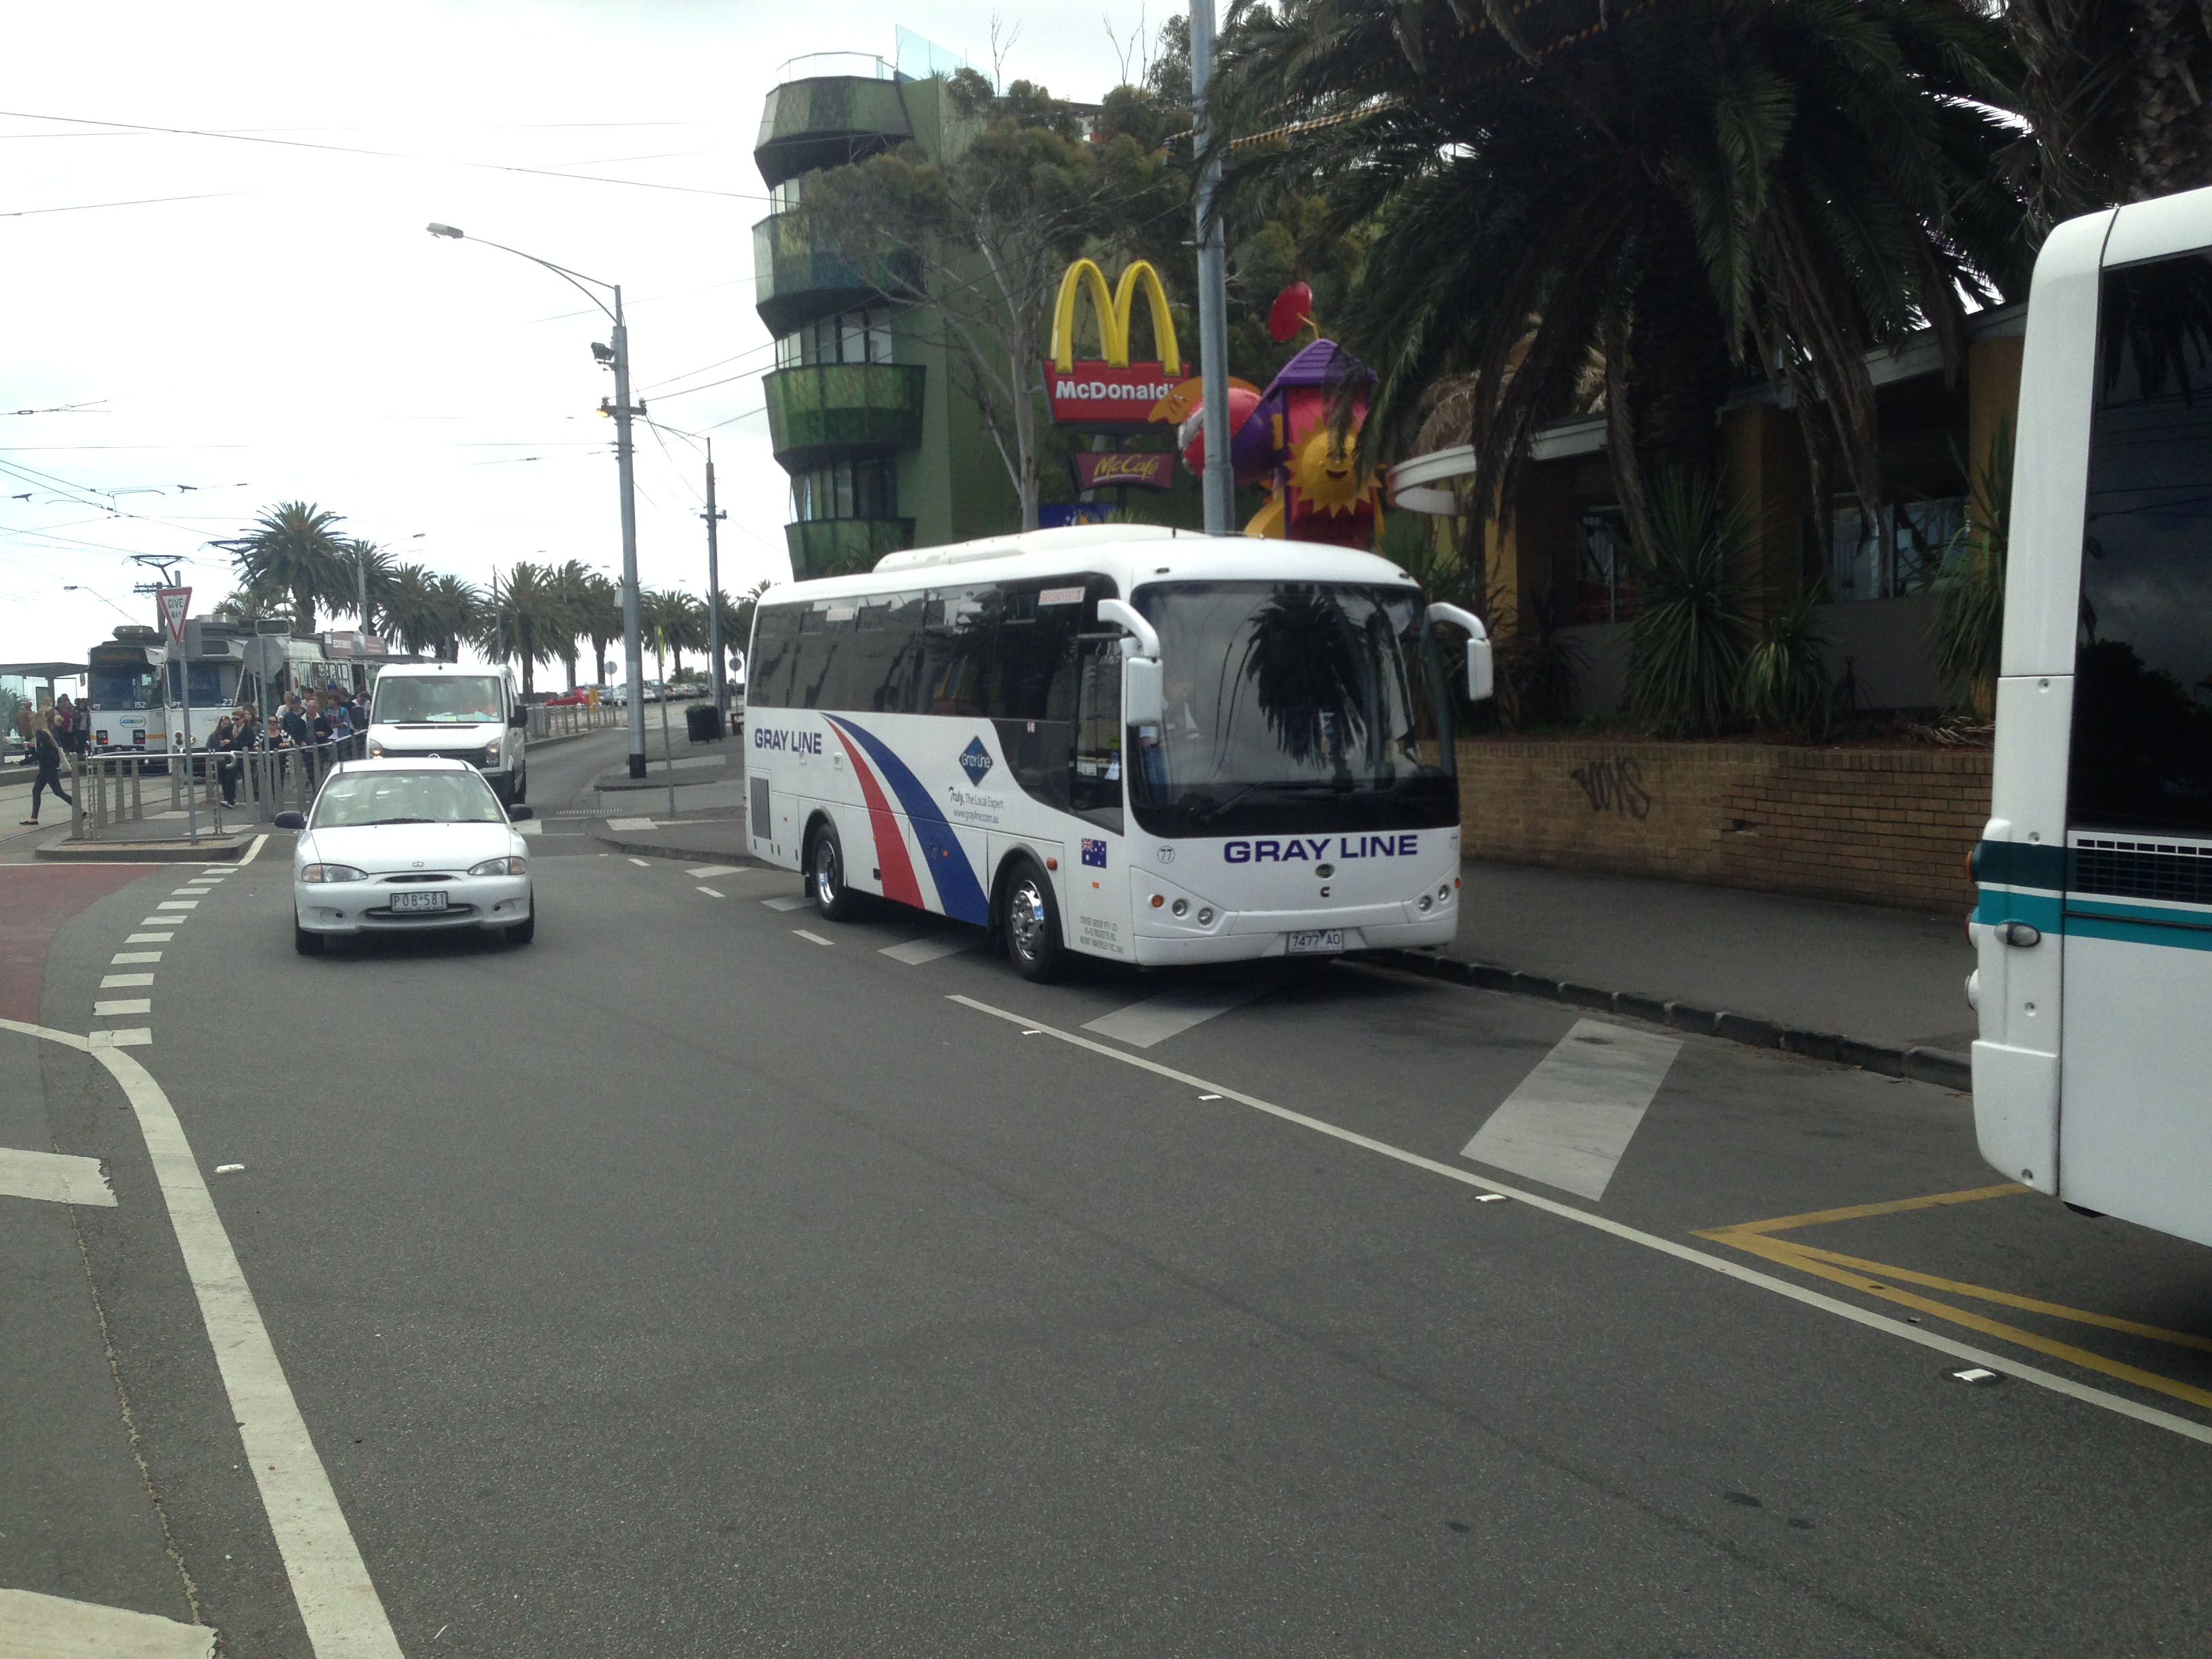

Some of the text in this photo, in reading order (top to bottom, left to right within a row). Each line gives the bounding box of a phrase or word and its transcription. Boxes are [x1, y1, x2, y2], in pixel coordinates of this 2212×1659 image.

[1055, 381, 1174, 400] McDonald'
[168, 598, 184, 609] GIVE
[755, 728, 822, 754] GRAY LINE
[965, 793, 975, 804] The
[975, 795, 987, 806] Local
[988, 796, 1003, 811] Expert
[1161, 848, 1172, 861] 77
[1224, 834, 1418, 863] GRAY LINE
[1292, 935, 1319, 947] 7477
